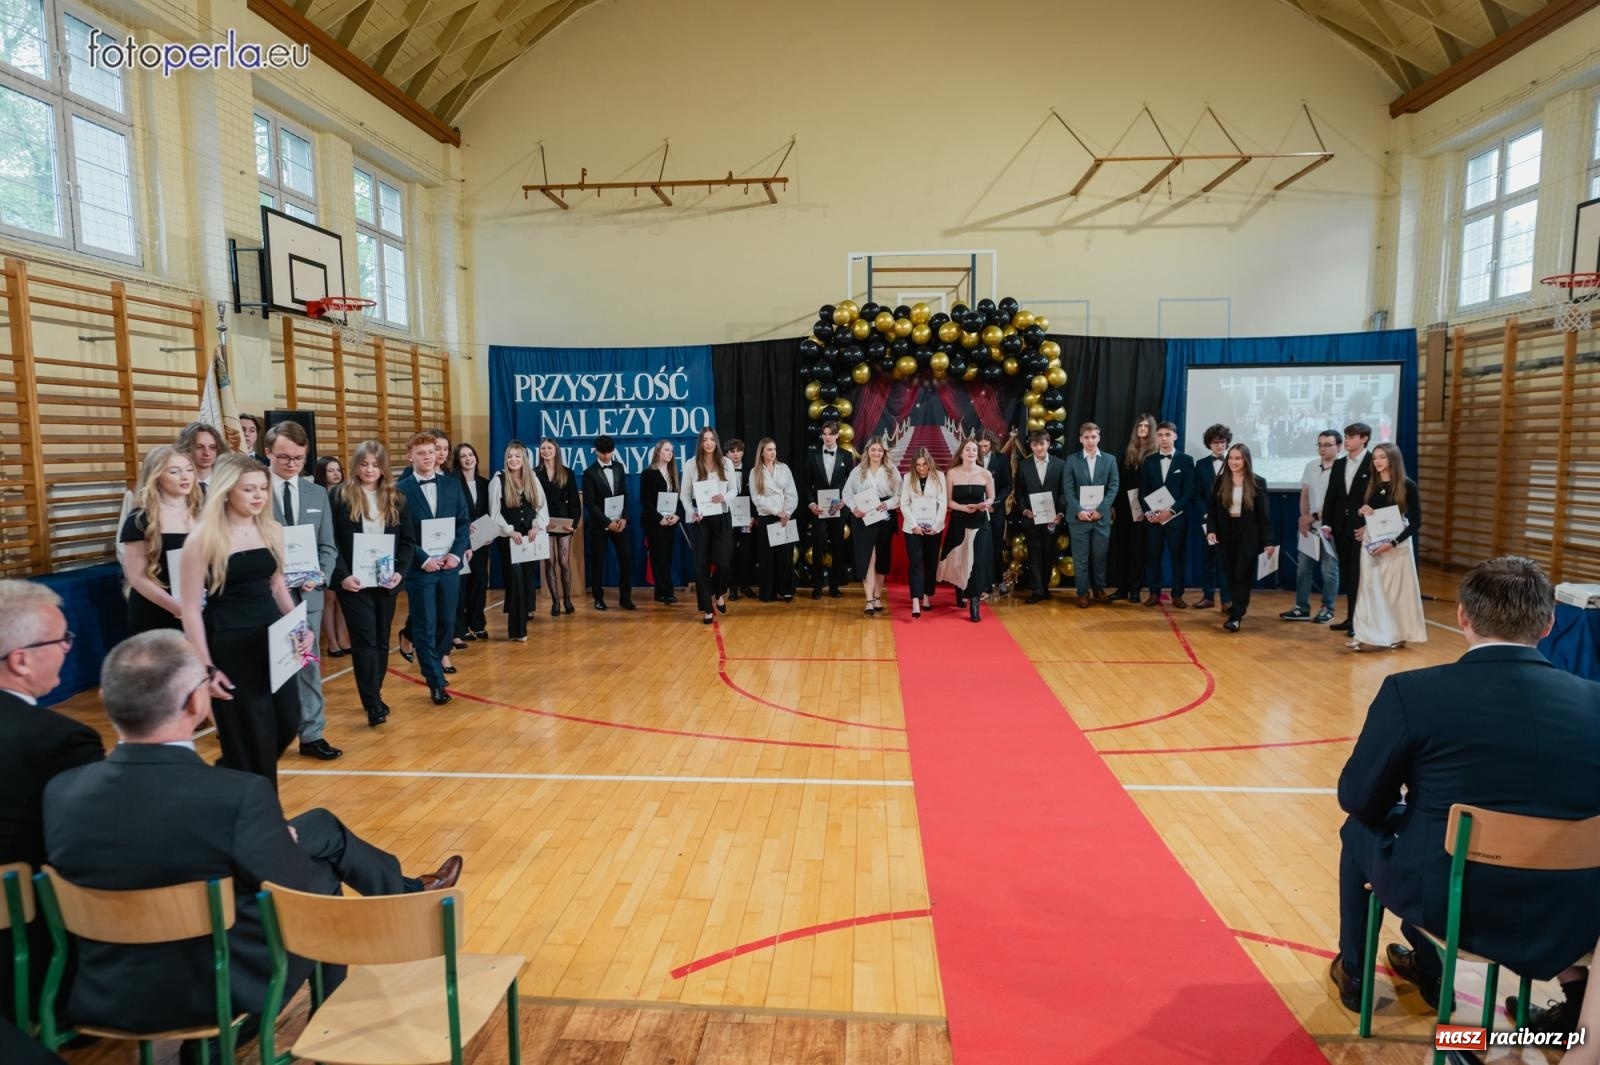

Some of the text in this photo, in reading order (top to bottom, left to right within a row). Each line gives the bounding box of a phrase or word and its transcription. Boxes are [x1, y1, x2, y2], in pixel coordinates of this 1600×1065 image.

[514, 365, 689, 402] PRZYSZŁOŚĆ
[540, 404, 710, 437] NALEŻY DO
